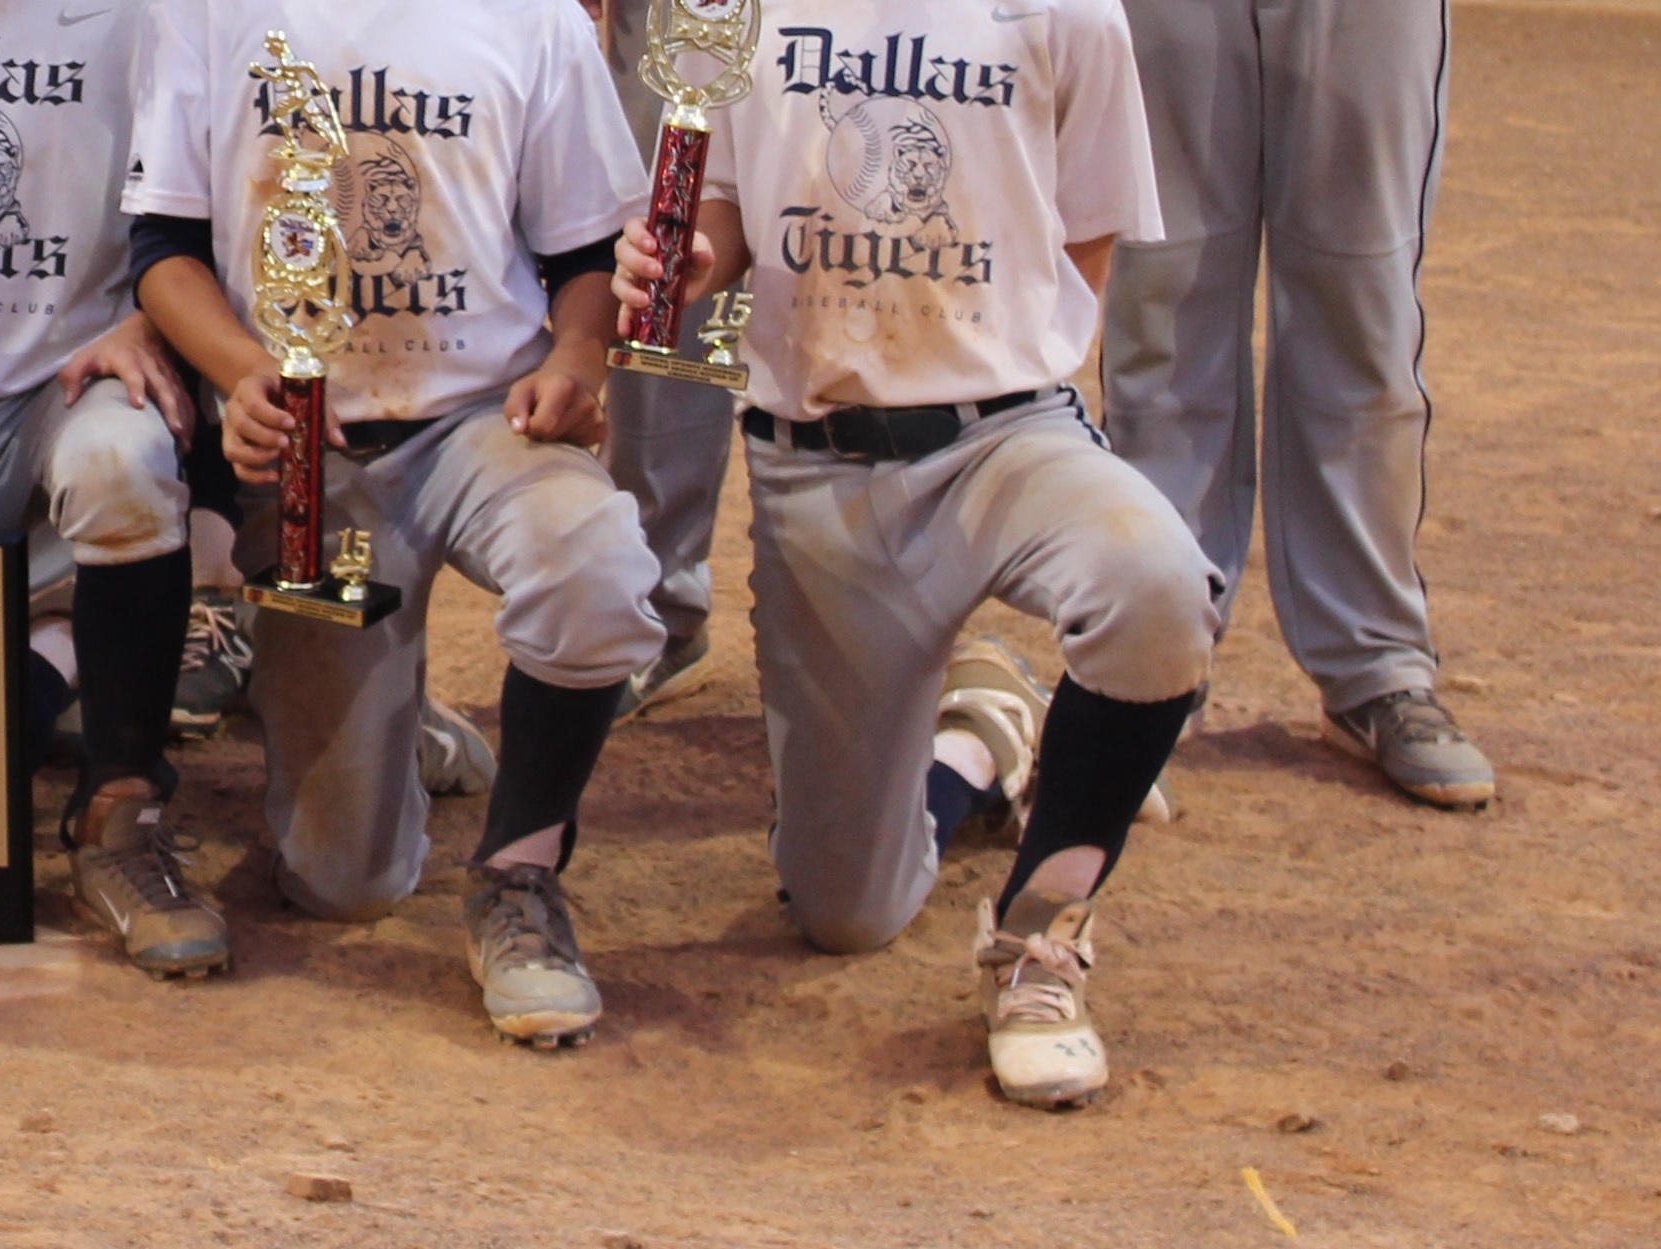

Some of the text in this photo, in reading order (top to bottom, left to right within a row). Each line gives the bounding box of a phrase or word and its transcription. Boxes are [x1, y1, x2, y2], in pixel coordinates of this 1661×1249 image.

[777, 26, 1018, 108] Dallas
[779, 206, 993, 288] Tigers
[328, 269, 467, 328] gers
[707, 291, 754, 327] 15
[791, 296, 982, 323] BSEBALL CLUB
[337, 528, 373, 564] 15
